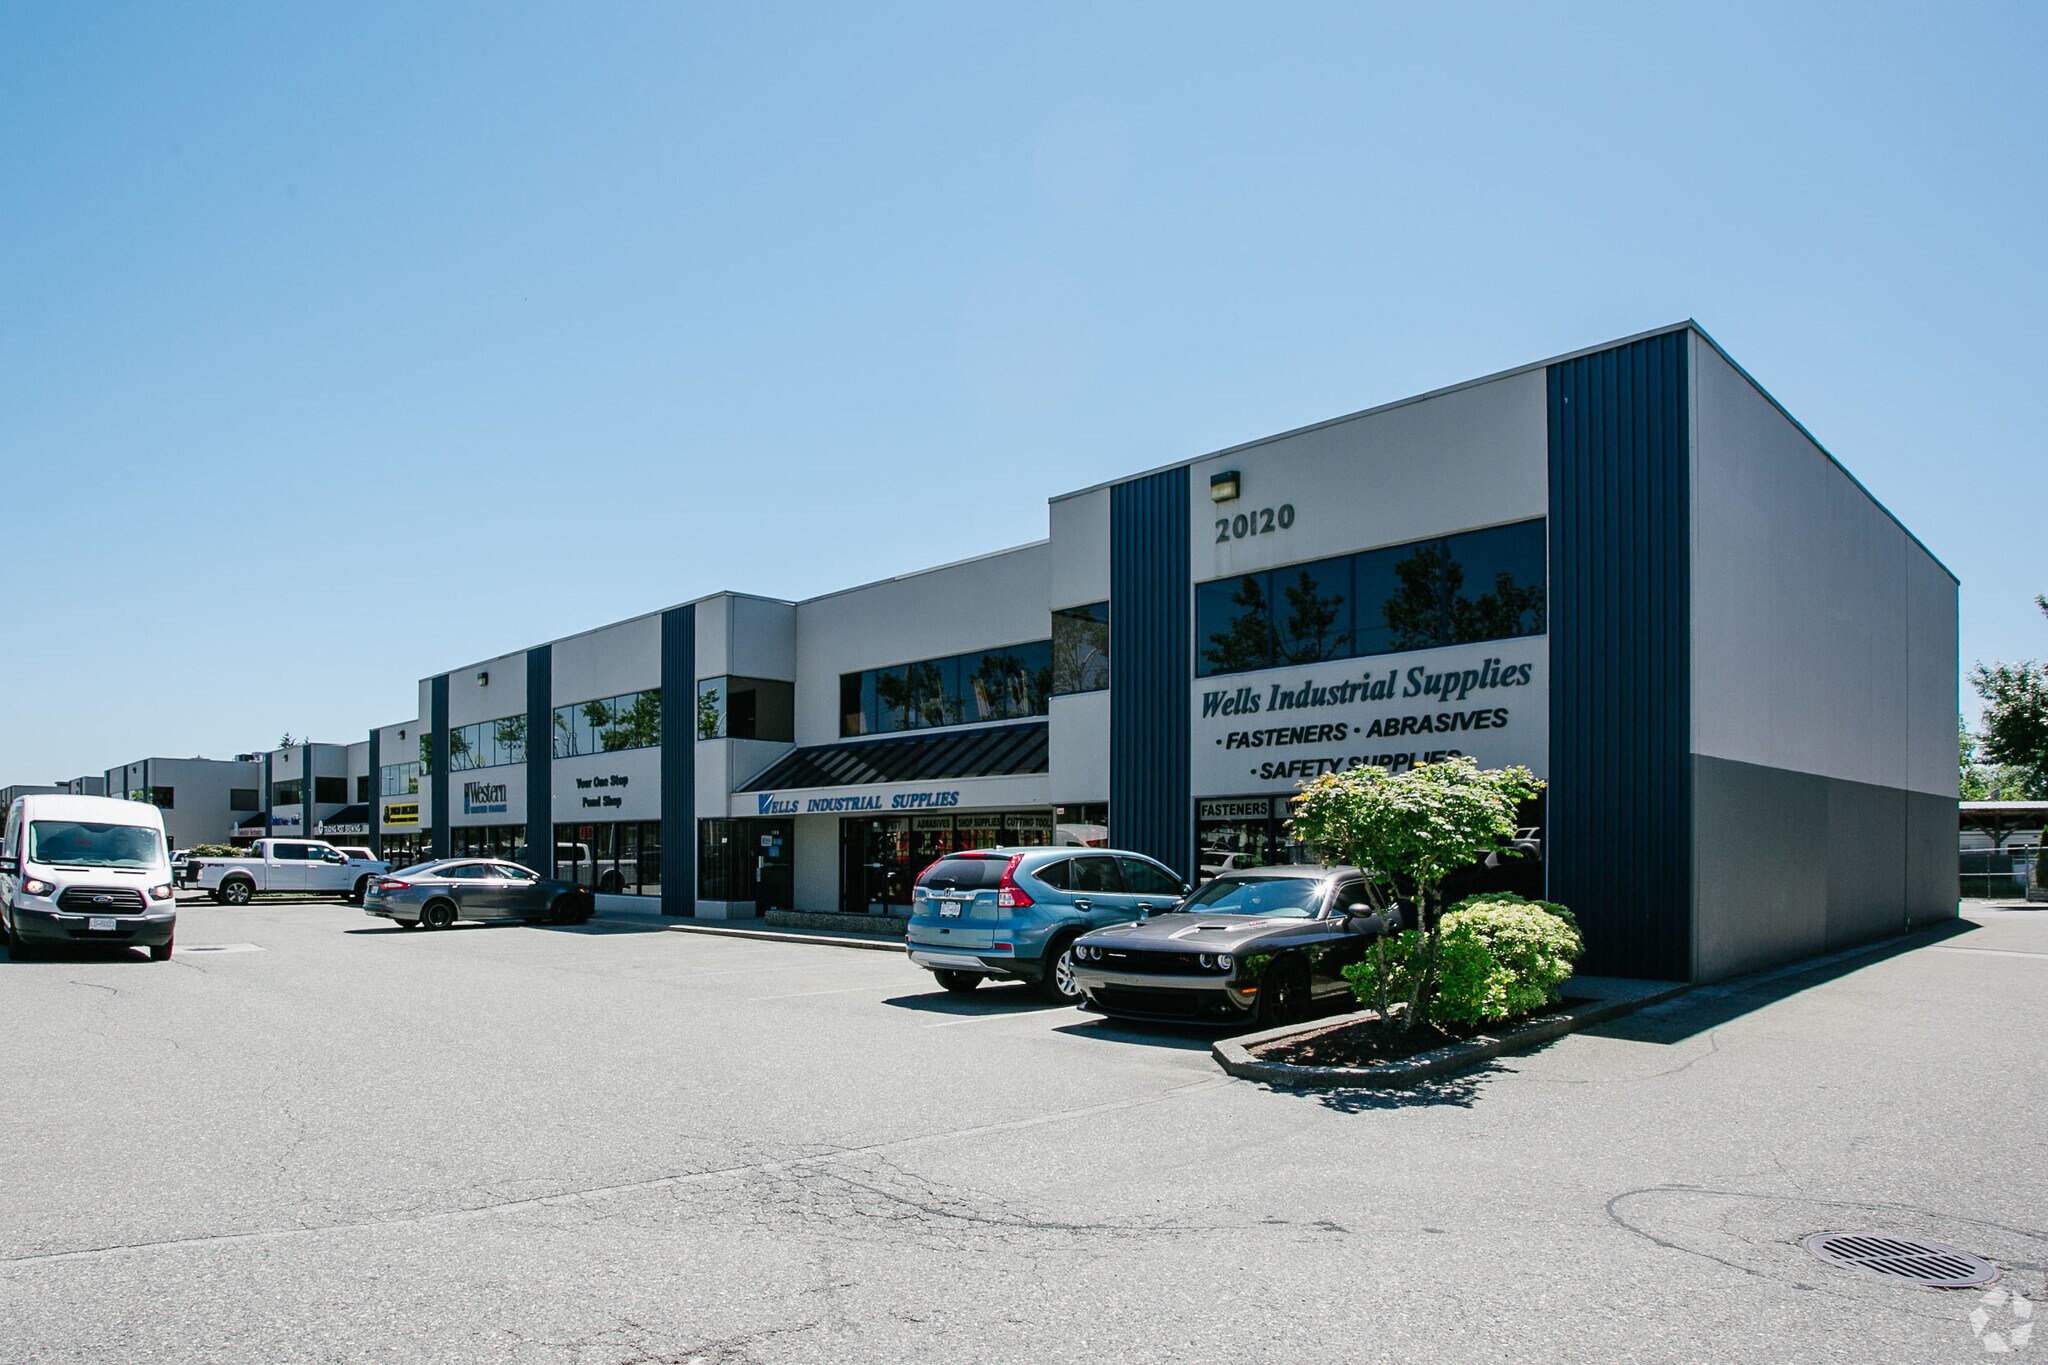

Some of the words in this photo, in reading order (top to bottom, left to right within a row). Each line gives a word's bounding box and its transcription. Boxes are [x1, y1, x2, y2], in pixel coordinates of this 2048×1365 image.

[1215, 503, 1295, 545] 20120
[1202, 686, 1261, 719] Wells
[1266, 669, 1398, 712] Industrial
[1402, 657, 1533, 703] Supplies
[1225, 722, 1349, 750] FASTENERS
[1366, 707, 1509, 739] ABRASIVES
[1259, 757, 1344, 780] SAFETY
[469, 781, 507, 804] Western
[807, 795, 882, 813] INDUSTRIAL
[892, 791, 960, 809] SUPPLIES
[1201, 802, 1268, 817] FASTENERS
[917, 818, 951, 829] ABRASIVES
[958, 817, 973, 828] SHOP
[974, 816, 1000, 827] SUPPLIES
[1006, 817, 1035, 827] CUTTING
